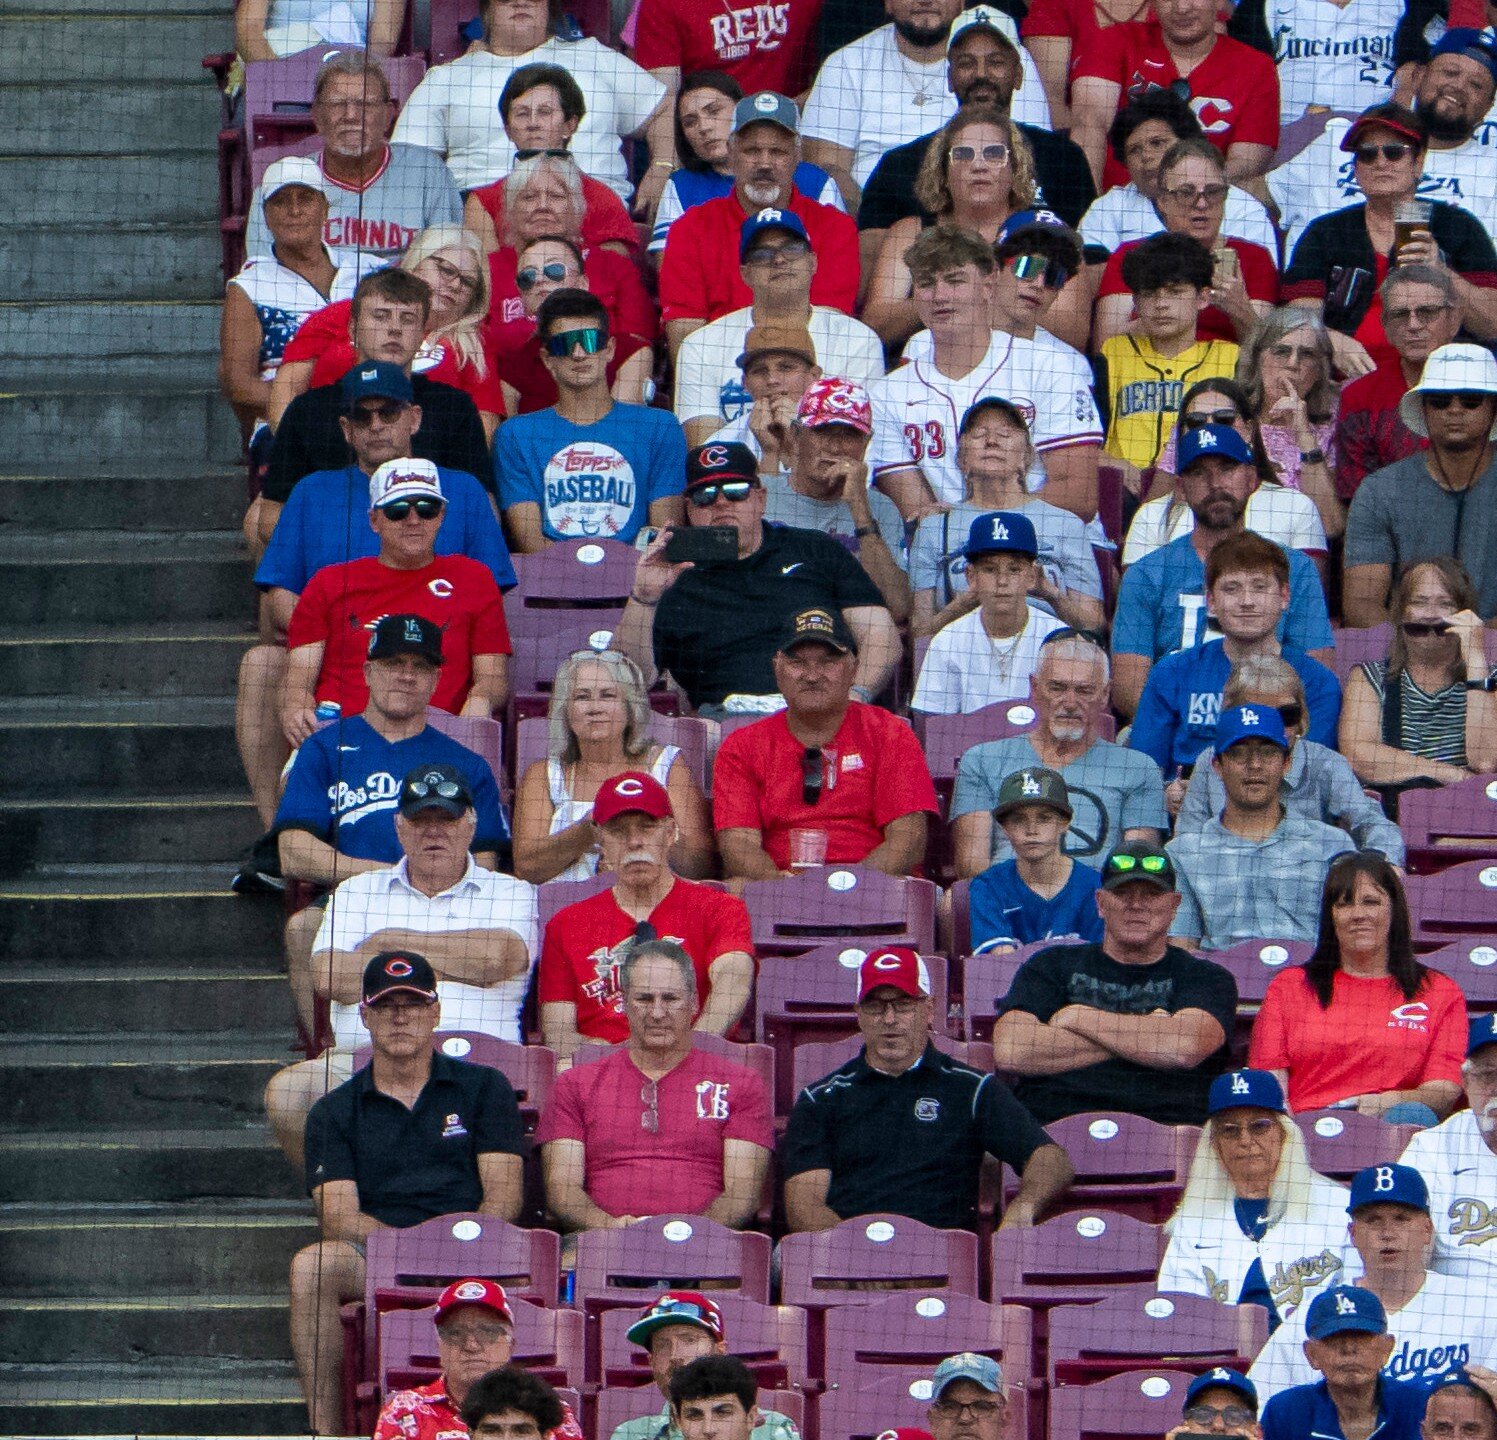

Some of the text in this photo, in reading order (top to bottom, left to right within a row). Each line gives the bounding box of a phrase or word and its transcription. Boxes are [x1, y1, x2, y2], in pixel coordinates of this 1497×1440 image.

[710, 3, 791, 50] REDS
[1275, 24, 1396, 64] Cincinnat
[1191, 96, 1233, 134] C
[323, 216, 418, 251] CINNAT
[903, 420, 946, 462] 33
[1197, 428, 1218, 448] LA
[699, 444, 729, 469] C
[545, 474, 633, 509] BASEBALL
[992, 517, 1009, 541] LA
[427, 578, 455, 597] C
[1239, 706, 1260, 726] LA
[614, 778, 643, 796] C
[1021, 772, 1042, 796] LA
[384, 959, 414, 977] C
[874, 953, 901, 971] C
[1390, 1001, 1429, 1022] C
[1231, 1072, 1251, 1095] LA
[1374, 1166, 1396, 1193] B
[1334, 1292, 1358, 1315] LA
[1383, 1340, 1471, 1378] dgers
